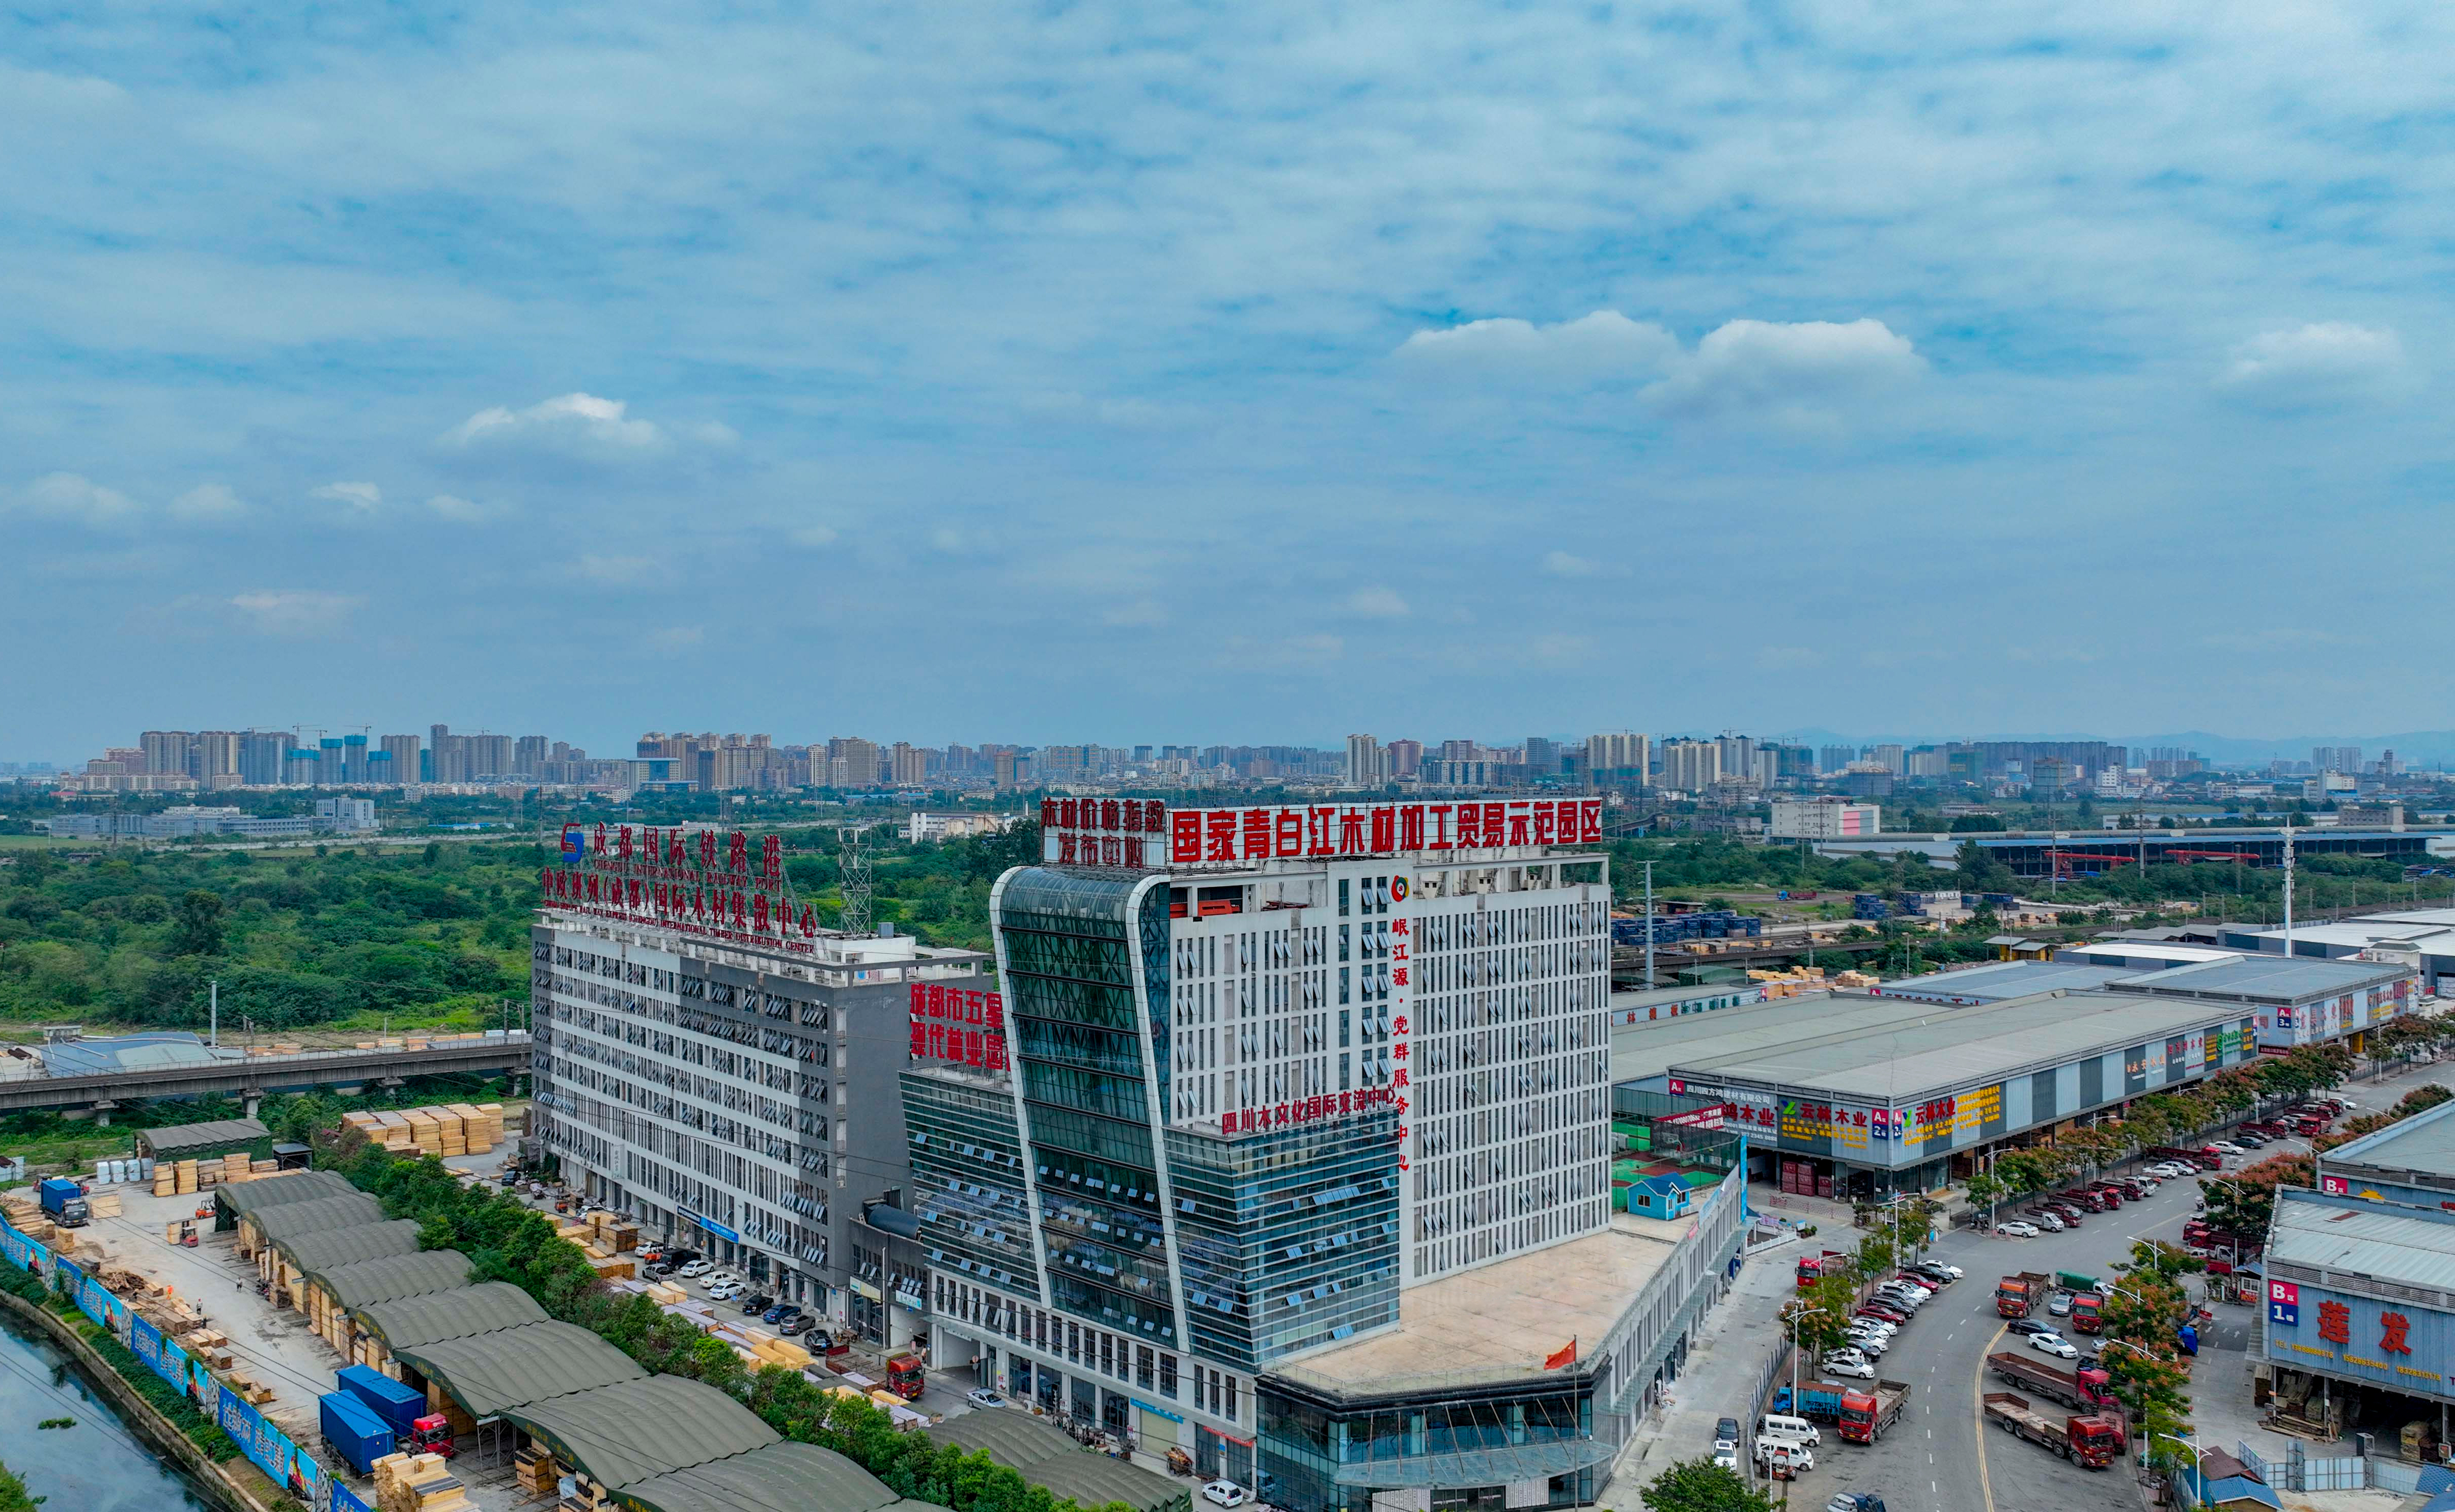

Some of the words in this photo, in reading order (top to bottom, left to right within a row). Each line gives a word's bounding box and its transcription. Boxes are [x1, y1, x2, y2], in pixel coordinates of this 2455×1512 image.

[1041, 797, 1164, 832] 木材价格指数
[1173, 800, 1602, 863] 国家青白江木材加工贸易示范园区
[593, 821, 782, 877] 成都国际铁路港
[1058, 833, 1143, 869] 发布中心
[594, 859, 629, 872] CHENGDU
[634, 864, 701, 882] INTERNATIONAL
[707, 871, 748, 887] RAILWAY
[755, 877, 782, 892] PORT
[785, 941, 815, 954] CENTER
[910, 1021, 1011, 1072] 现代林业园
[1222, 1084, 1396, 1135] 四川木文化国际交流中心
[1687, 1084, 1771, 1105] 四川四方鸿建材有限公司
[1915, 1097, 1956, 1125] 云林木业
[1800, 1103, 1867, 1127] 云林木业
[2273, 1284, 2294, 1302] B区
[2318, 1300, 2412, 1355] 莲发
